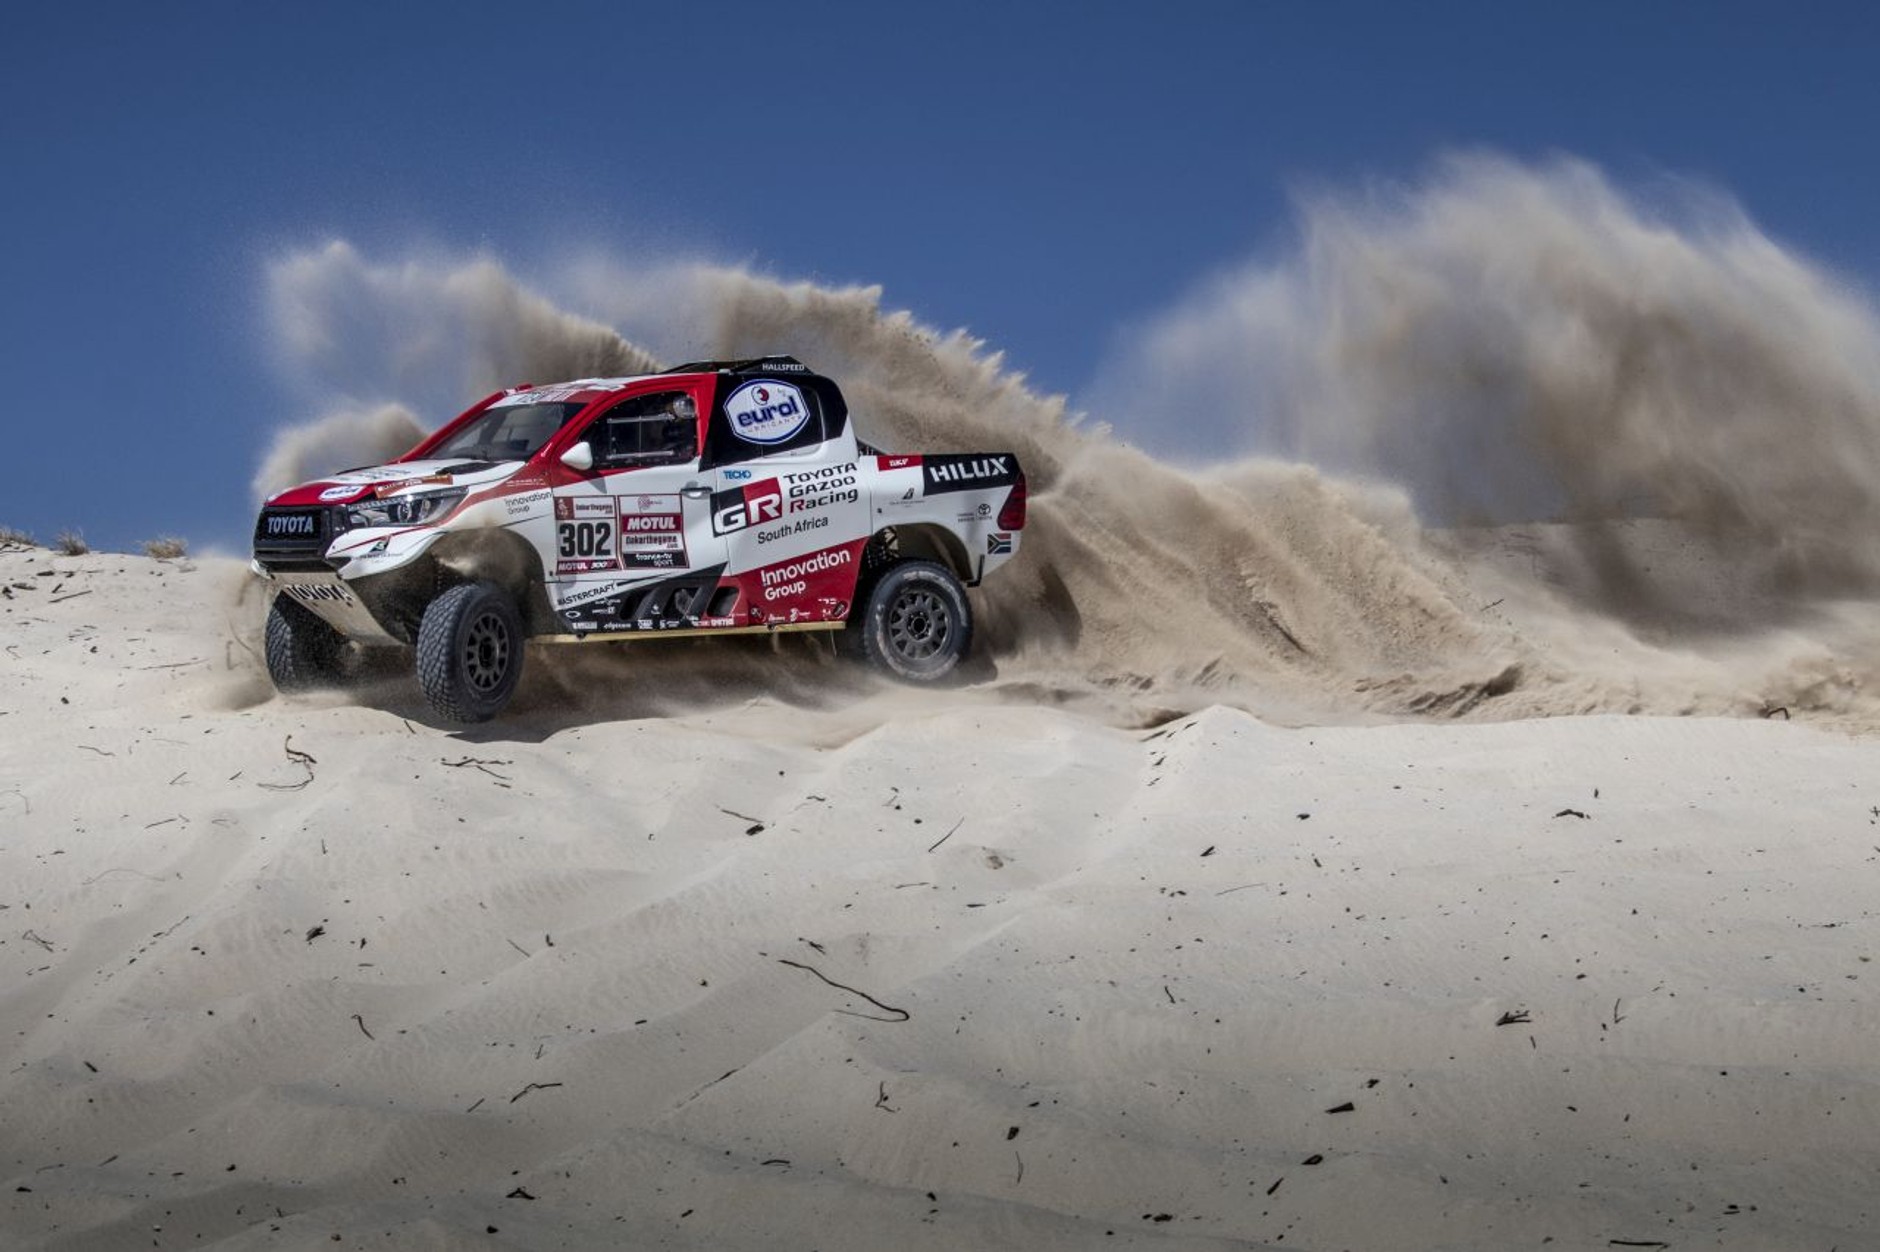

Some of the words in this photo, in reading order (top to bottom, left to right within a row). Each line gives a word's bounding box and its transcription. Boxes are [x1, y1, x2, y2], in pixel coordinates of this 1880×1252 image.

[762, 363, 805, 371] HALLSPEED
[737, 396, 799, 427] eurol
[723, 470, 752, 480] TECHO
[784, 462, 858, 485] TOYOTA
[929, 456, 1009, 482] HILUX
[789, 476, 856, 498] GAZOO
[789, 488, 859, 514] Racing
[267, 515, 314, 534] TOYOTA
[627, 517, 677, 531] MOTUL
[713, 493, 780, 534] GR
[559, 522, 611, 557] 302
[758, 527, 792, 544] South
[794, 515, 829, 534] Africa
[558, 562, 588, 571] MOTUL
[761, 549, 851, 587] Innovation
[285, 584, 354, 600] TOYOTA
[765, 581, 806, 601] Group
